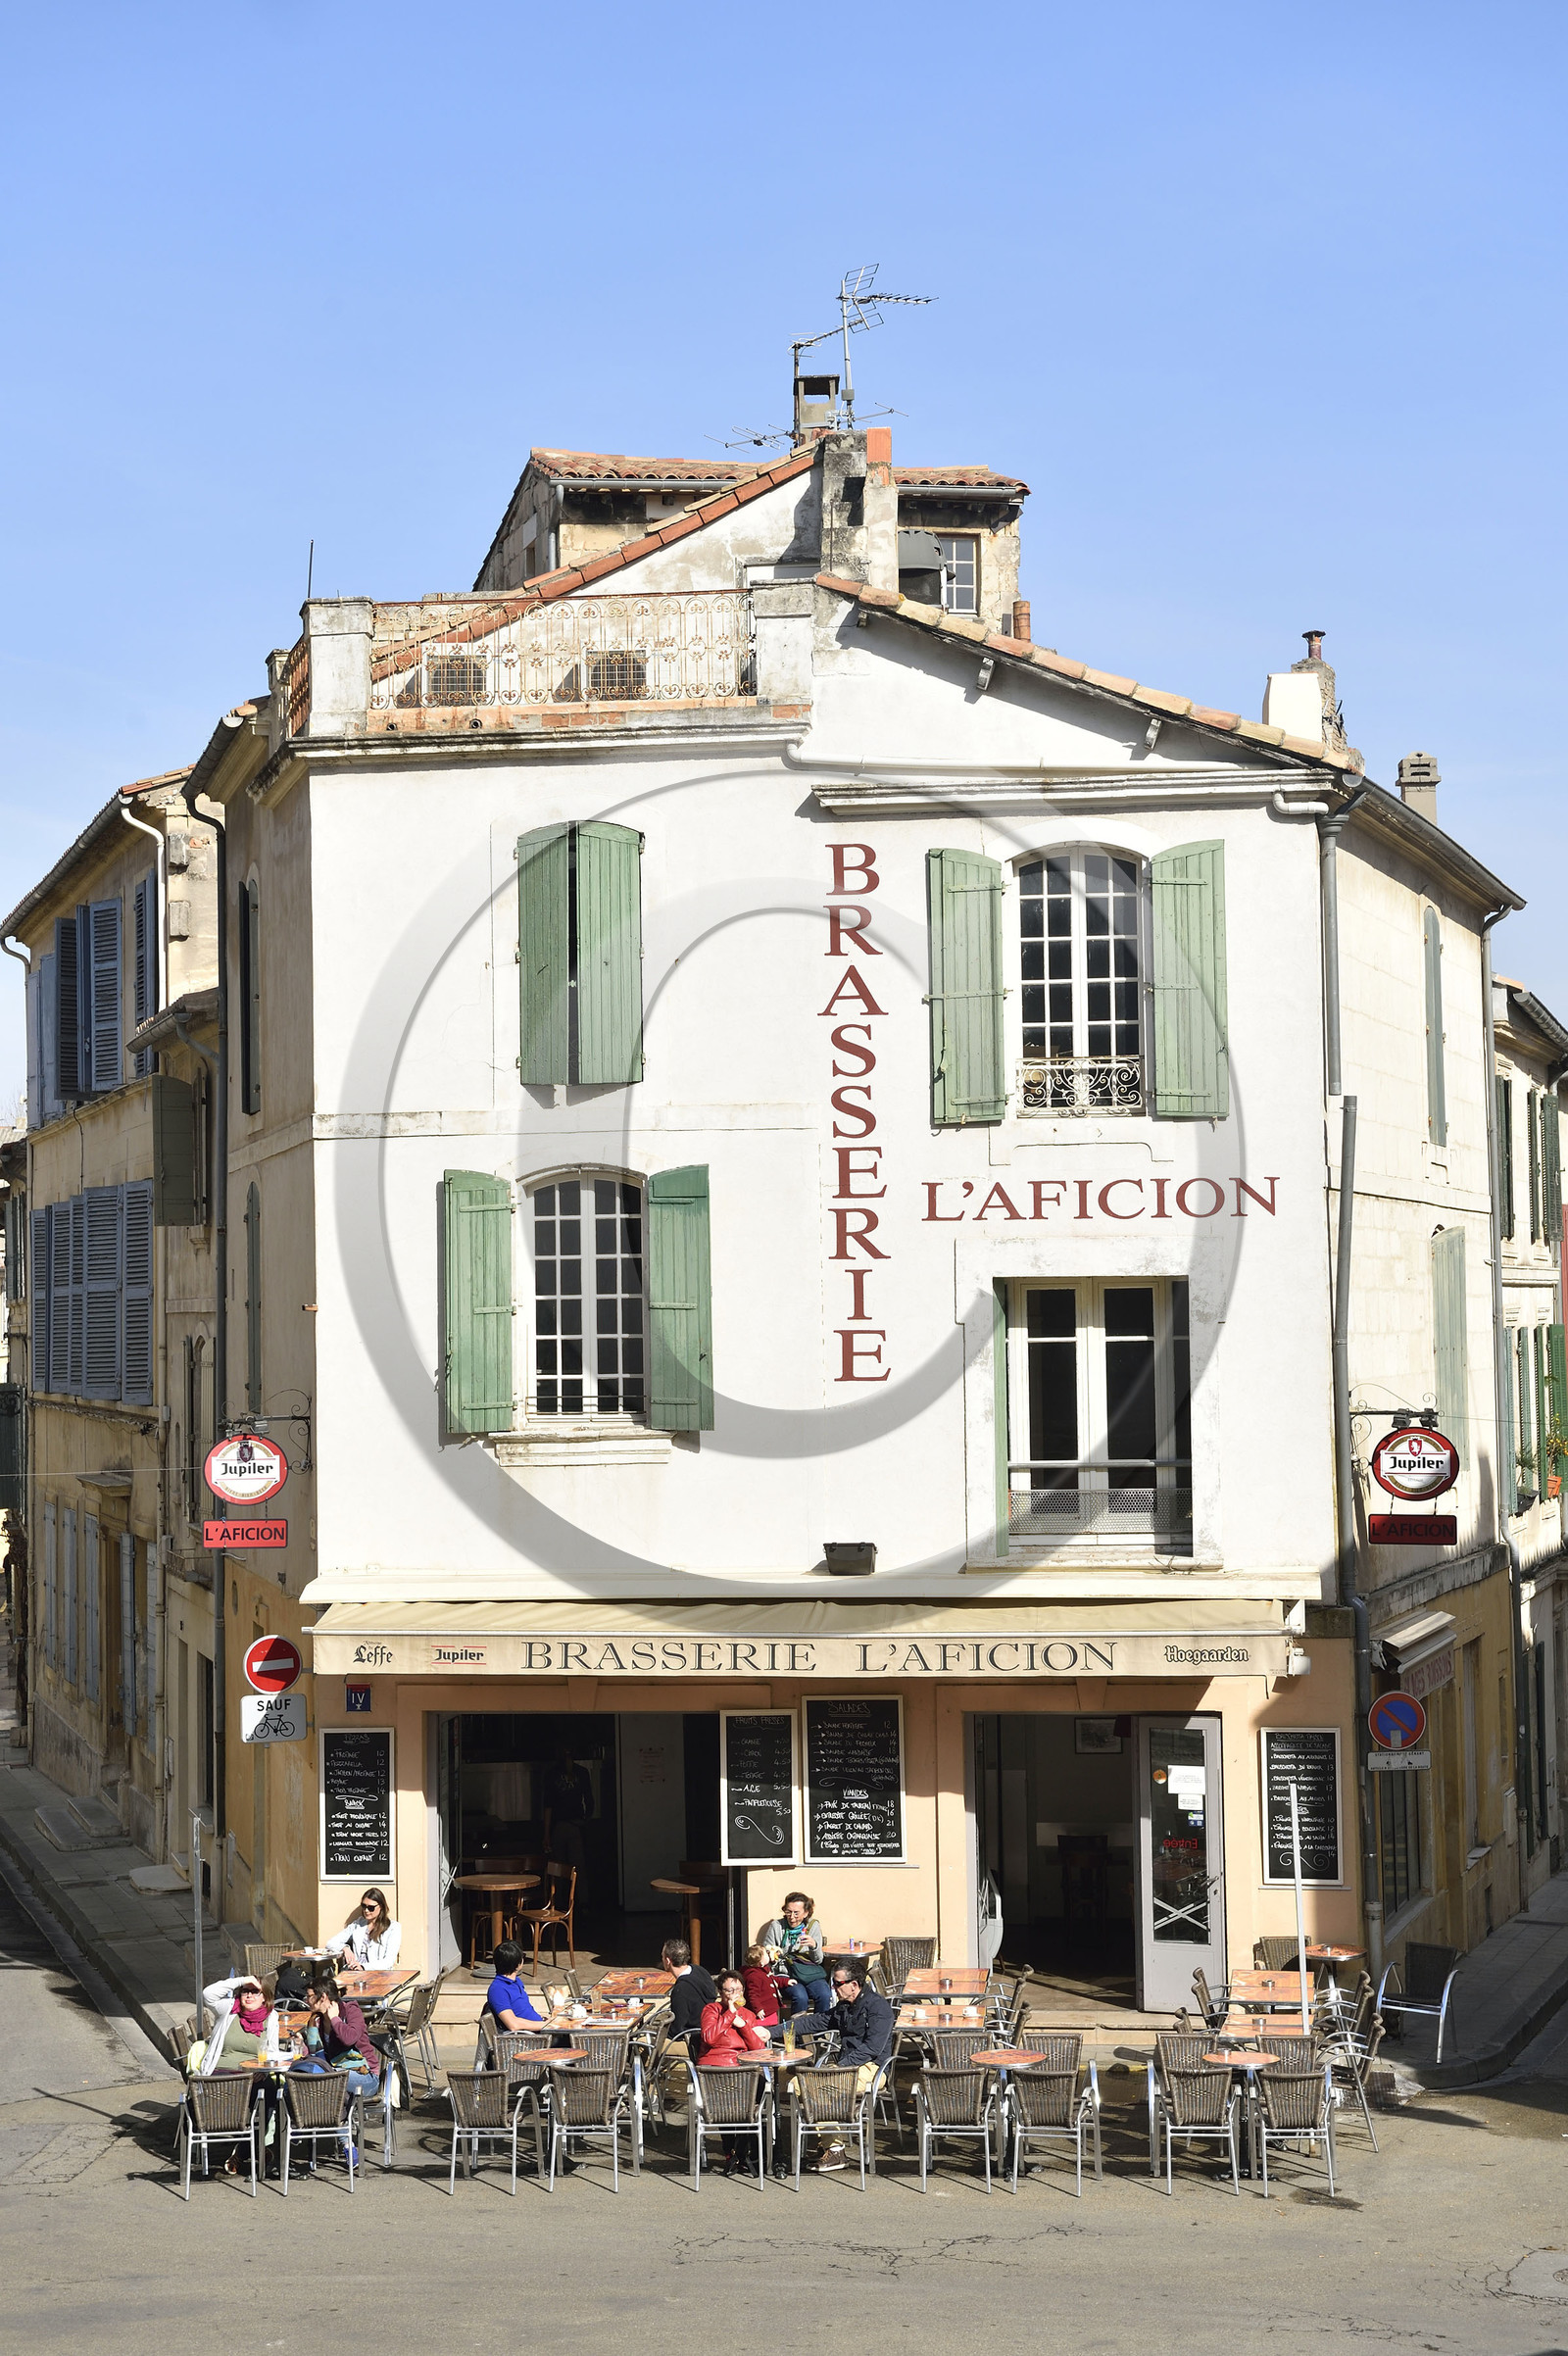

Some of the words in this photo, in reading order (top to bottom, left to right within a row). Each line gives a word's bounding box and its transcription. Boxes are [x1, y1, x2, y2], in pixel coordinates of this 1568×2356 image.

[817, 844, 891, 1382] BRASSERIE
[921, 1176, 1280, 1222] L'AFICION
[220, 1462, 273, 1477] Jupiler
[1389, 1456, 1445, 1472] Jupiler
[353, 1644, 394, 1667] Leffe
[434, 1648, 484, 1663] Jupiler
[521, 1641, 817, 1671] BRASSERIE
[856, 1642, 1117, 1672] L'AFICION
[1164, 1644, 1250, 1666] Hoegaarden
[257, 1698, 291, 1712] SAUF
[350, 1693, 366, 1704] IV
[827, 1701, 871, 1714] SALADES
[1326, 1763, 1335, 1772] 13
[886, 1799, 895, 1809] 18
[379, 1820, 387, 1829] 14
